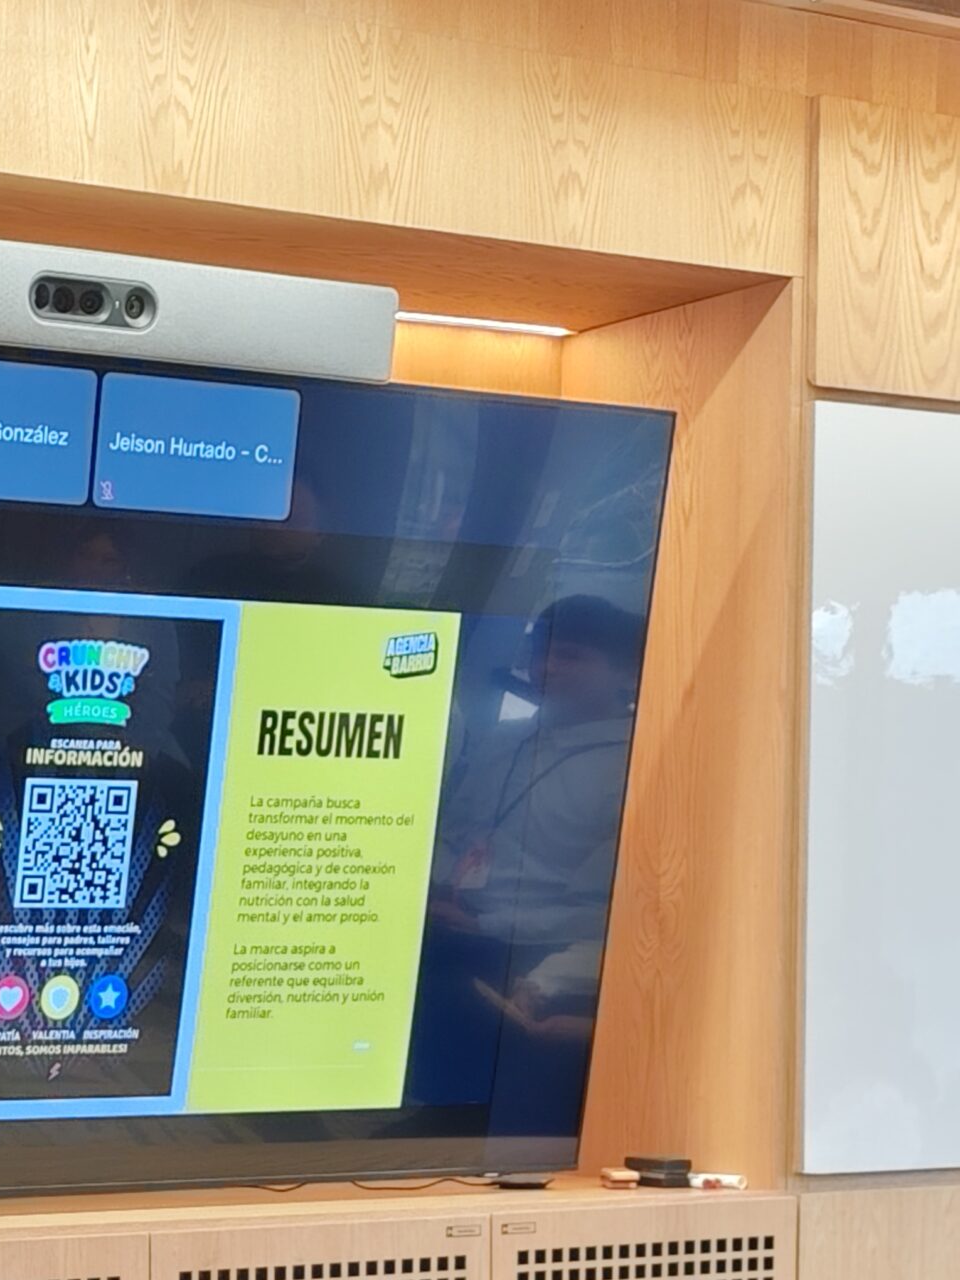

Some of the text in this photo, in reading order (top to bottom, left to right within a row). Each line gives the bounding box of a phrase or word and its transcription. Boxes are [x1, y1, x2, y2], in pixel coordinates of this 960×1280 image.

[109, 431, 165, 456] Jeison
[170, 437, 236, 461] Hurtado
[386, 633, 435, 657] AGENCIA
[40, 642, 148, 673] CRUNCHY
[64, 668, 121, 694] KIDS
[63, 702, 118, 720] HÉROES
[257, 709, 405, 759] RESUMEN
[96, 740, 122, 751] PARA
[26, 747, 144, 768] INFORMACIÓN
[250, 795, 361, 810] La campaña busca
[248, 811, 415, 826] transformar el momento del
[246, 828, 347, 844] desayuno en una
[244, 845, 313, 860] experiencia
[242, 861, 396, 877] pedagógica y de conexión
[291, 878, 357, 893] integrando
[359, 878, 370, 890] la
[239, 894, 365, 907] nutrición con la salud
[237, 911, 280, 923] mental
[282, 913, 289, 925] y
[292, 911, 303, 922] el
[305, 912, 337, 922] amor
[35, 922, 55, 934] más
[56, 923, 81, 934] sobre
[83, 924, 101, 934] esta
[103, 922, 141, 935] emoción,
[1, 935, 131, 946] consejos para padres, talleres
[5, 946, 124, 958] y recursos para acompañar
[233, 942, 336, 957] La marca aspira a
[40, 958, 87, 969] a tus hijos.
[231, 959, 360, 974] posicionarse como un
[229, 974, 364, 989] referente que equilibra
[286, 990, 340, 1003] nutrición
[341, 993, 349, 1005] y
[351, 990, 385, 1002] unión
[83, 1027, 139, 1040] INSPIRACIÓN
[26, 1044, 61, 1055] SOMOS
[63, 1043, 127, 1055] IMPARABLES!
